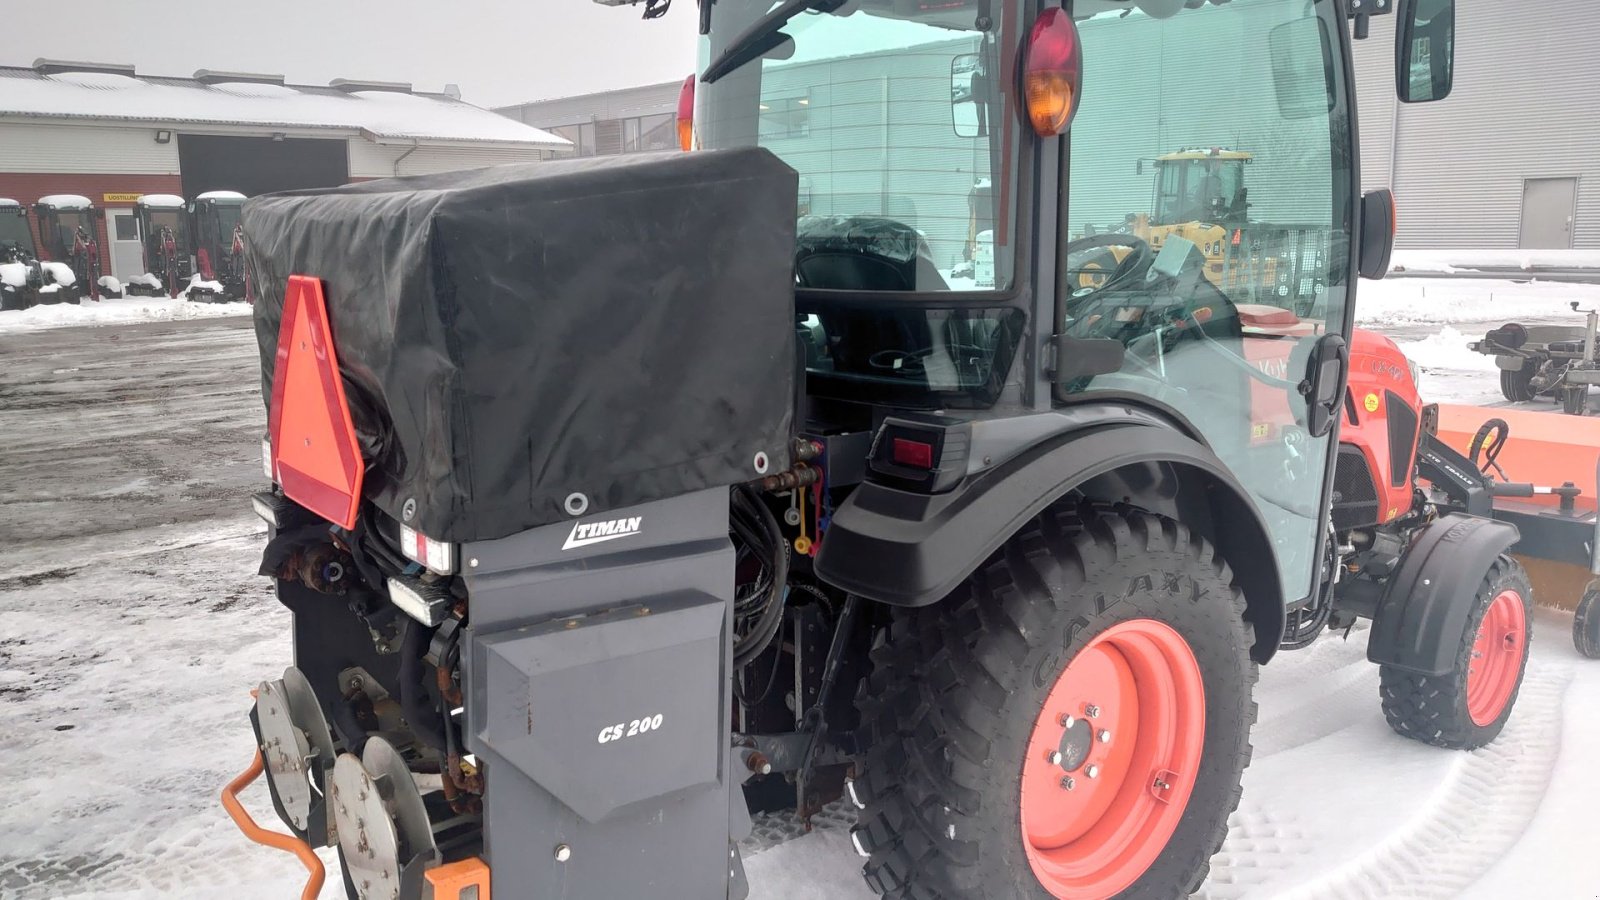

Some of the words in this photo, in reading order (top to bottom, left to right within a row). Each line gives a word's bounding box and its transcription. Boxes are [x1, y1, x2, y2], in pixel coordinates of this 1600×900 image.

[577, 516, 642, 539] TIMAN
[1033, 569, 1210, 689] GALAXY
[597, 722, 625, 744] CS
[626, 713, 663, 737] 200
